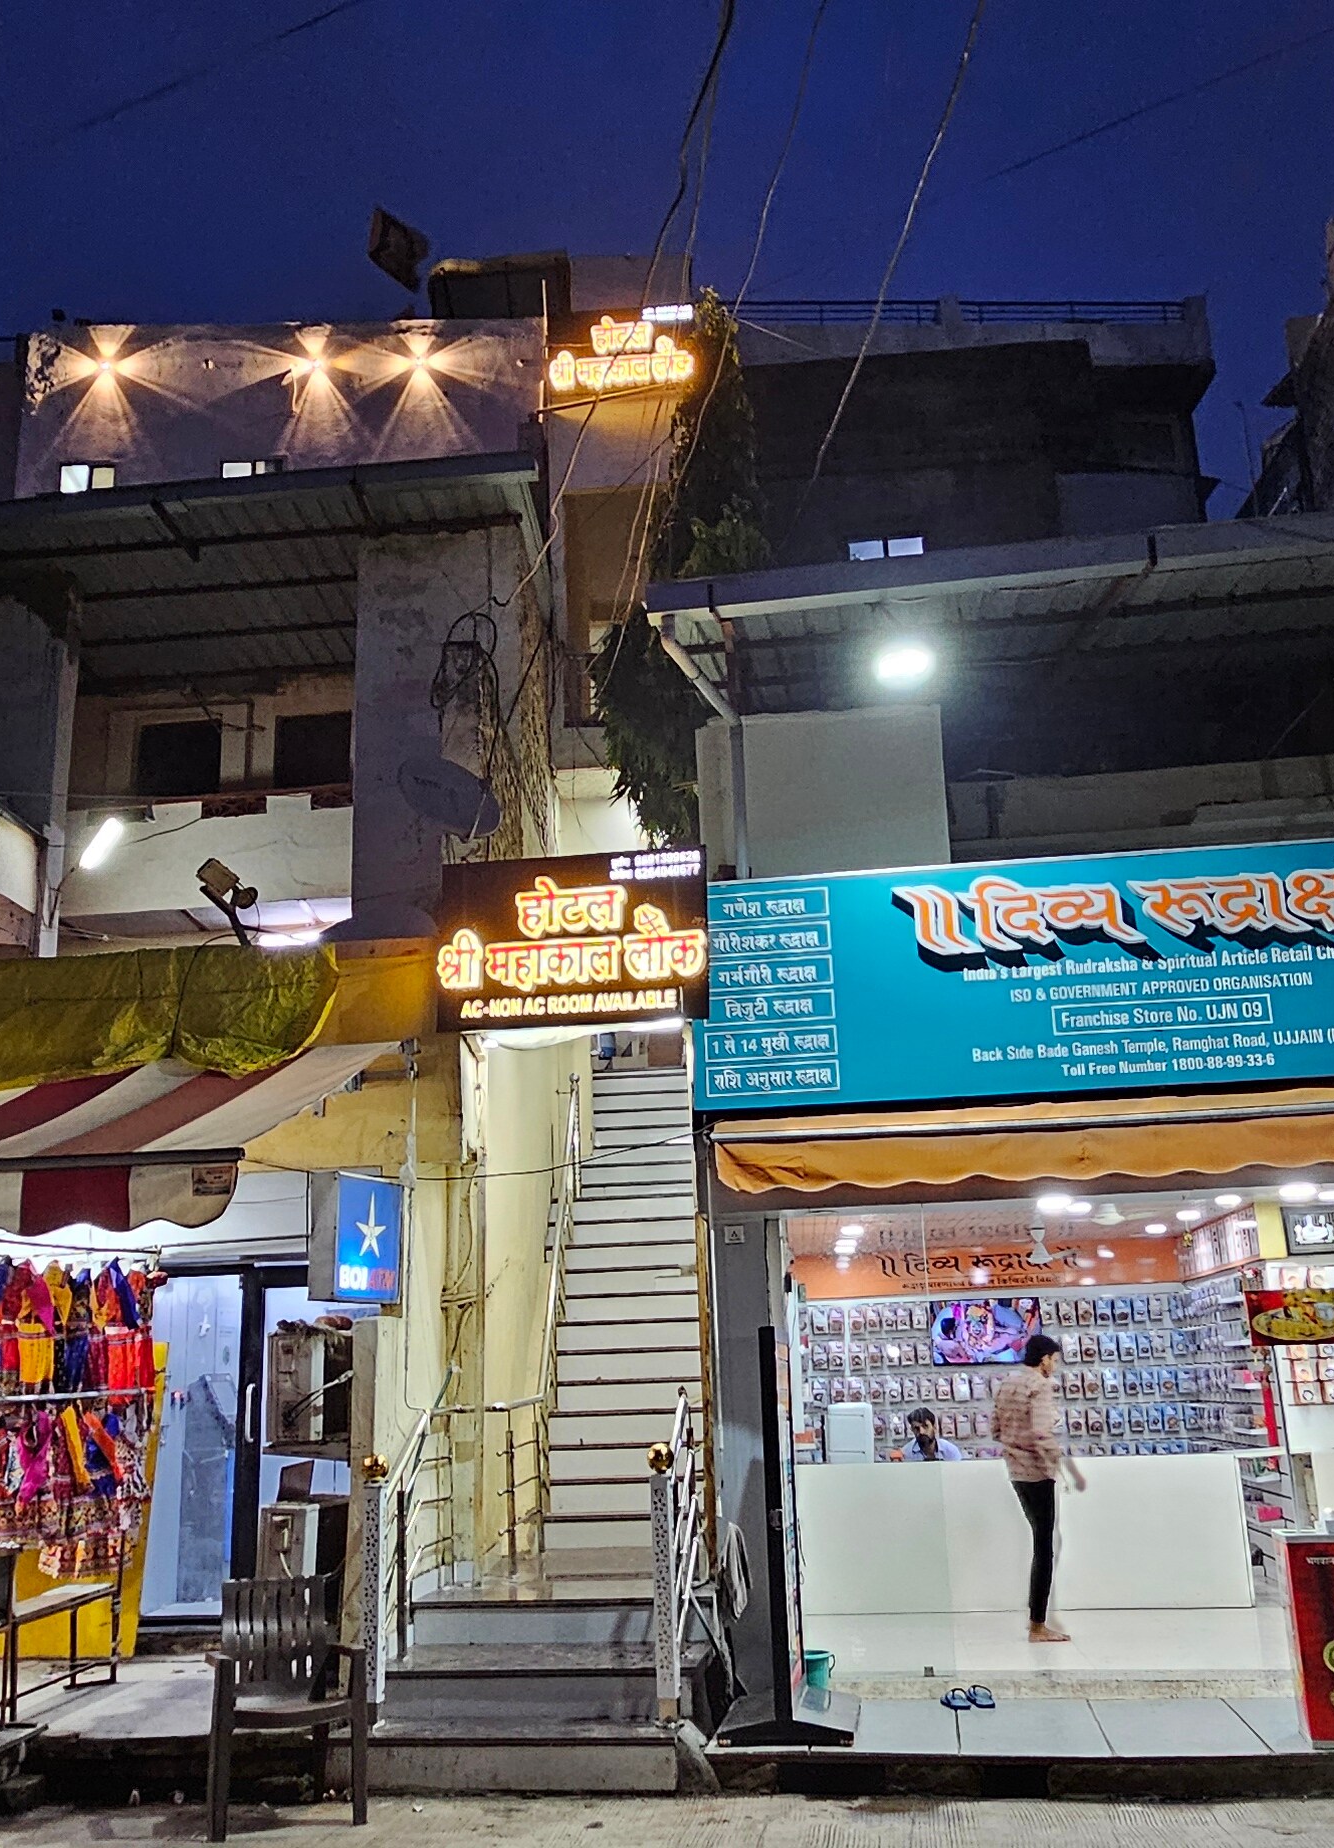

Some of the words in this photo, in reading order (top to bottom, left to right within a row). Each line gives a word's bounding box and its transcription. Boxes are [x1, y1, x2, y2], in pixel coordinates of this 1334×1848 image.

[515, 876, 627, 939] होटल
[722, 898, 762, 917] गणेश
[437, 929, 484, 990] श्री
[484, 936, 622, 992] महाकाल
[963, 967, 1009, 981] India's
[1011, 961, 1062, 980] Largest
[1066, 956, 1138, 975] Rudraksha
[1158, 951, 1217, 973] Spiritual
[1221, 948, 1268, 966] Article
[1271, 945, 1313, 963] Retail
[1011, 989, 1031, 1002] ISO
[1036, 988, 1047, 1001] &
[1050, 982, 1137, 999] GOVERNMENT
[1142, 978, 1209, 995] APPROVED
[1214, 972, 1313, 990] ORGANISATION
[523, 996, 545, 1016] AC
[547, 994, 593, 1014] ROOM
[594, 988, 677, 1012] AVAILABLE
[1061, 1010, 1129, 1028] Franchise
[1133, 1006, 1173, 1025] Store
[1177, 1006, 1202, 1022] No.
[1206, 1003, 1238, 1020] UJN
[1242, 1002, 1262, 1017] 09
[712, 1041, 718, 1054] 1
[724, 1034, 735, 1055] से
[740, 1038, 757, 1053] 14
[761, 1032, 789, 1056] मुखी
[972, 1047, 1004, 1062] Back
[1007, 1045, 1034, 1060] Side
[1038, 1043, 1069, 1059] Bade
[1072, 1040, 1119, 1056] Ganesh
[1121, 1038, 1168, 1056] Temple,
[1172, 1035, 1229, 1052] Ramghat
[1233, 1032, 1270, 1048] Road,
[1273, 1029, 1323, 1046] UJJAIN
[1062, 1064, 1085, 1077] Toll
[1089, 1062, 1116, 1075] Free
[1119, 1060, 1166, 1074] Number
[1172, 1053, 1275, 1071] 1800-88-99-33-6
[714, 1069, 741, 1090] राशि
[746, 1071, 793, 1091] अनुसार
[339, 1264, 368, 1290] BOI
